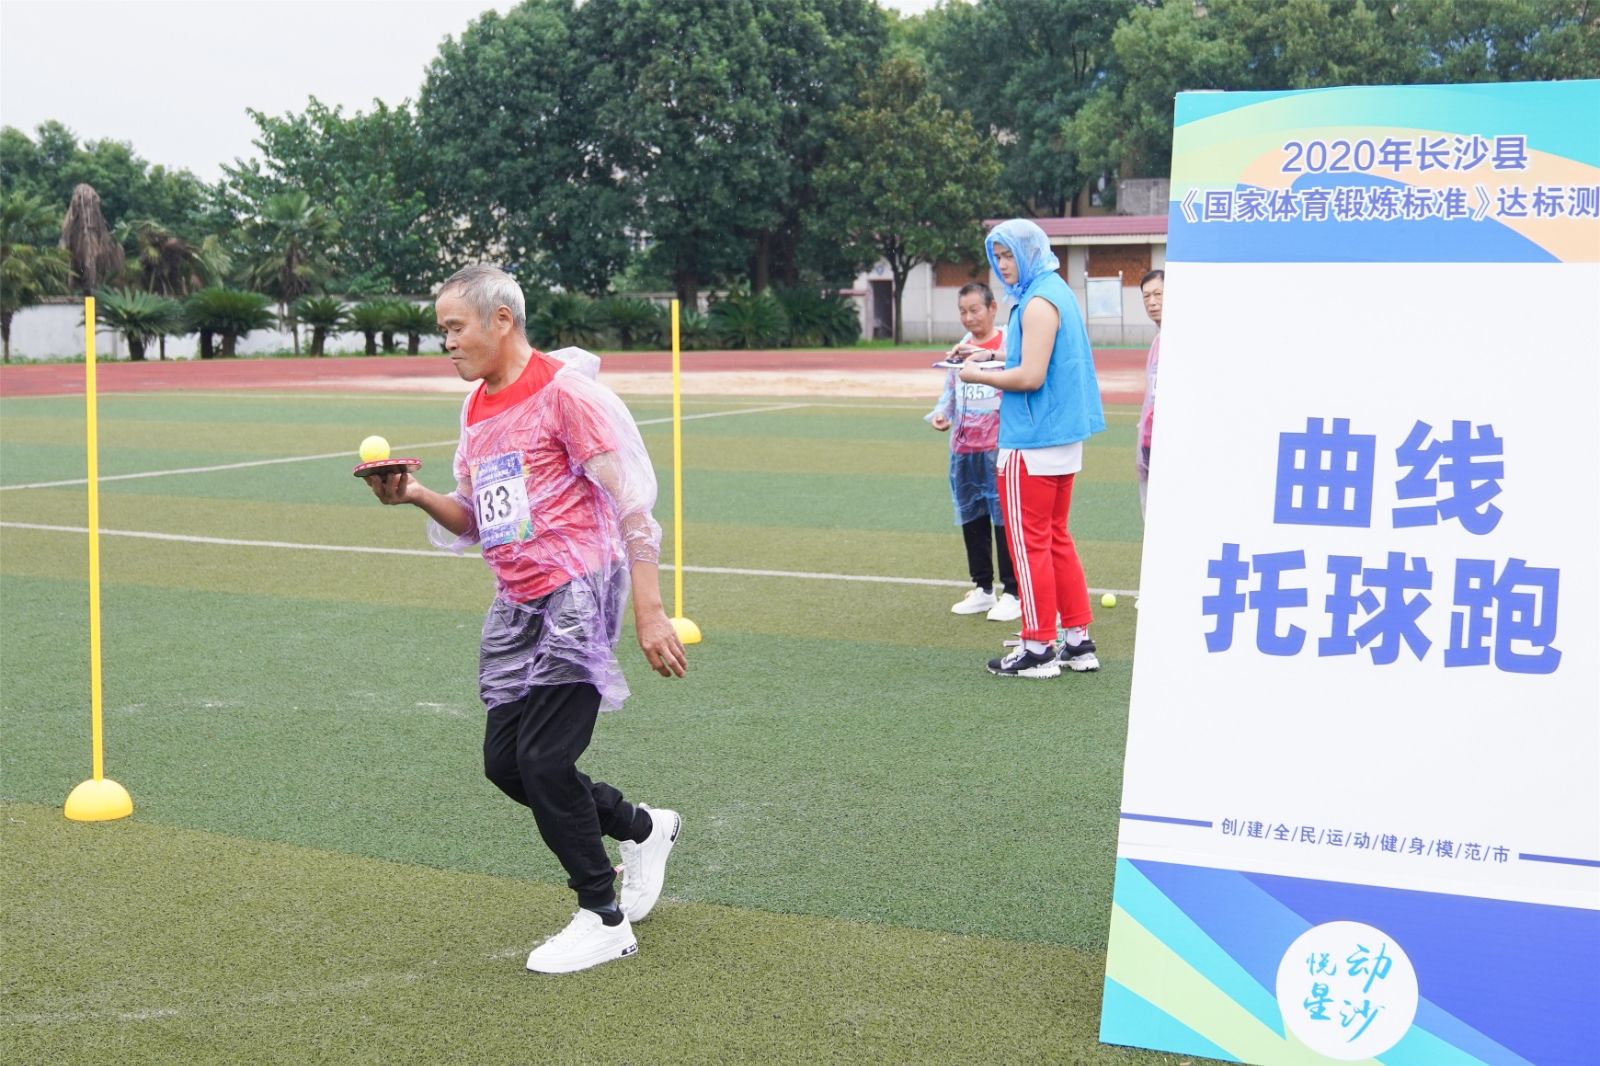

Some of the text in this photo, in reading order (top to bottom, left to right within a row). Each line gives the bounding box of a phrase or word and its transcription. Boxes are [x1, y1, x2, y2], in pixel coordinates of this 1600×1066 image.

[1281, 135, 1529, 173] 2020年长沙县
[1179, 186, 1600, 222] 《国家体育锻炼标准》达标测
[1273, 416, 1504, 536] 曲线
[475, 485, 512, 526] 133
[1202, 542, 1562, 675] 托球跑
[1305, 942, 1393, 994] 悦动
[1303, 981, 1386, 1043] 星沙
